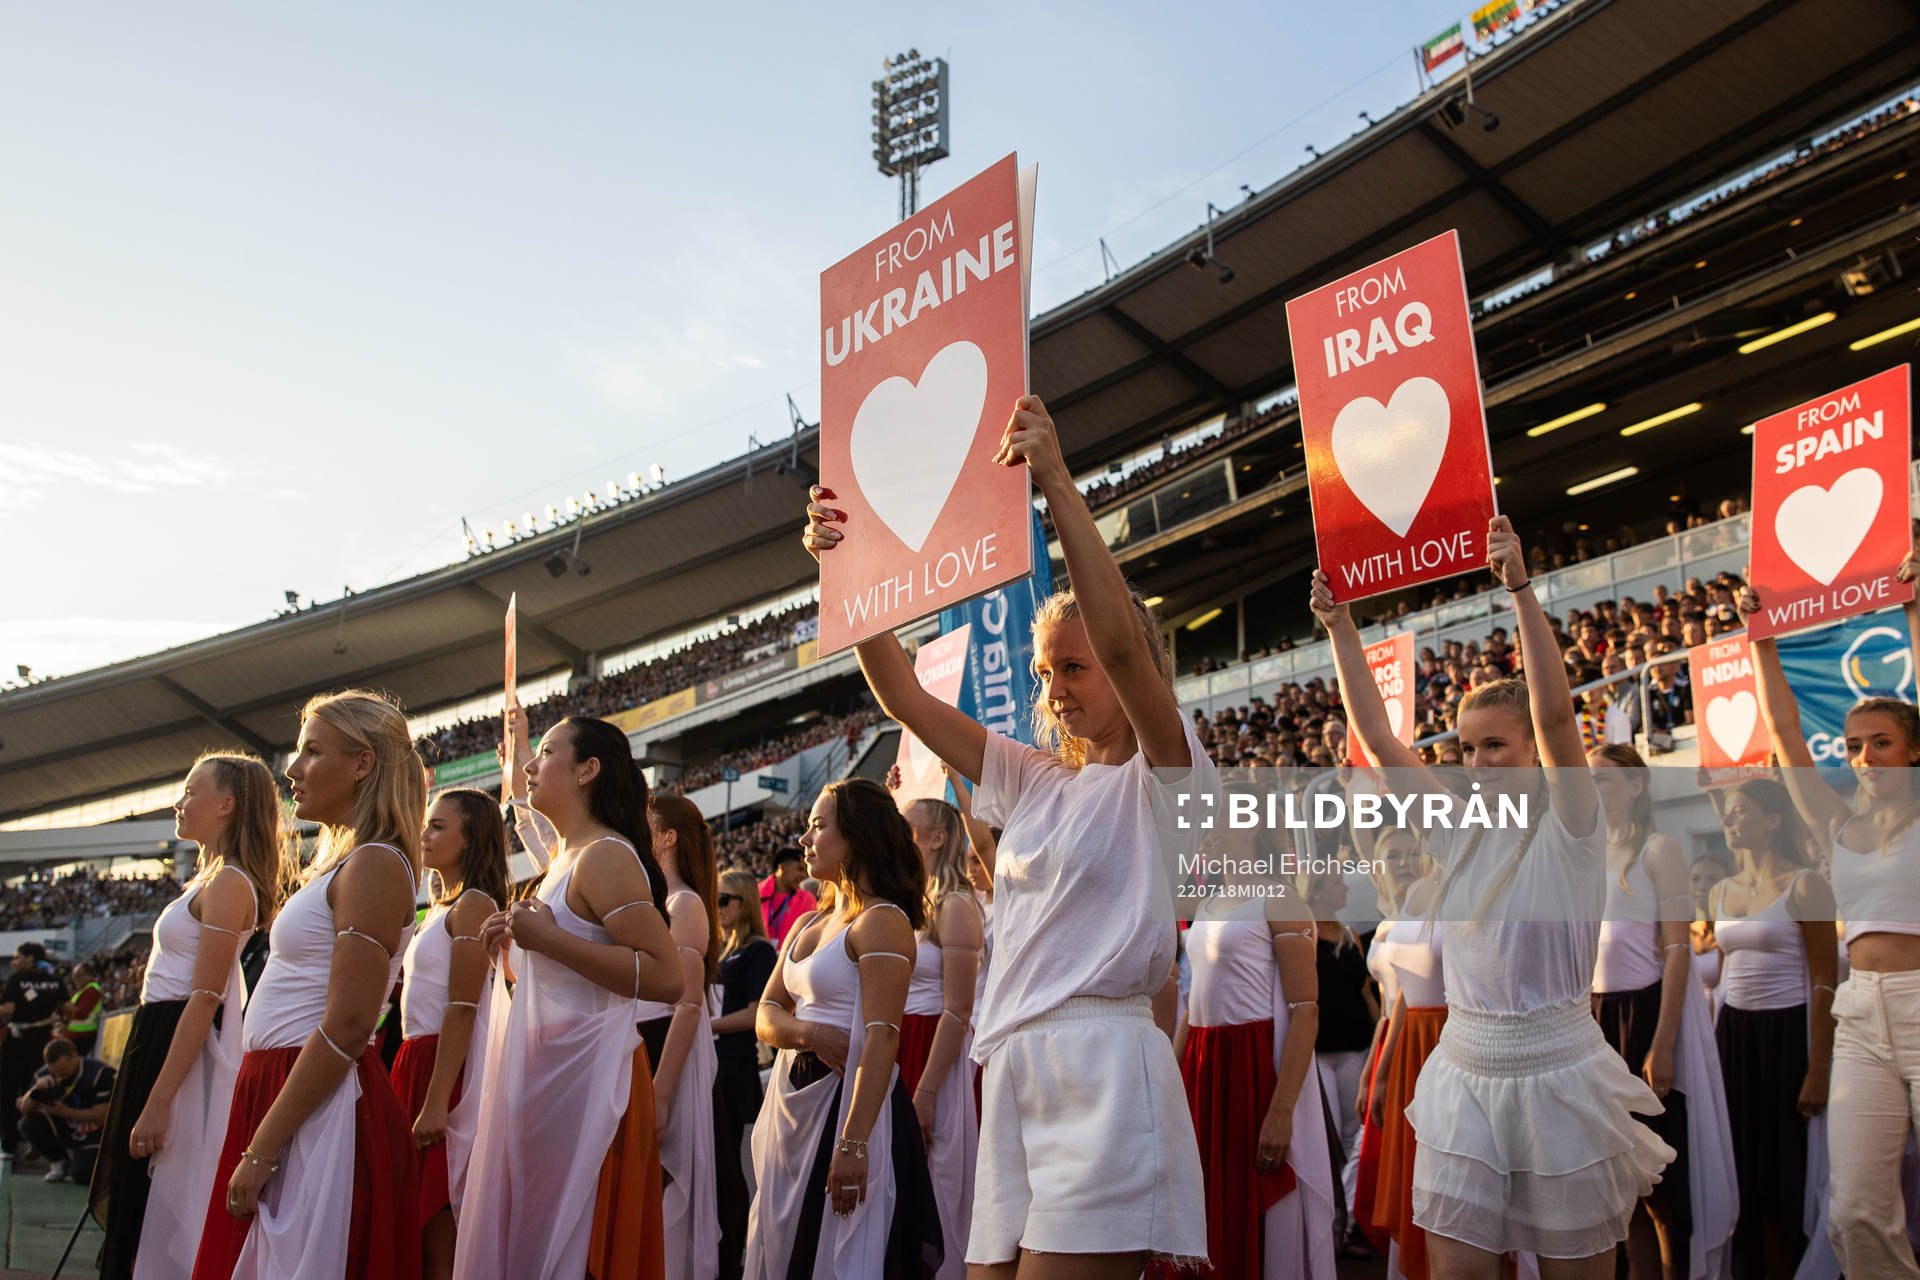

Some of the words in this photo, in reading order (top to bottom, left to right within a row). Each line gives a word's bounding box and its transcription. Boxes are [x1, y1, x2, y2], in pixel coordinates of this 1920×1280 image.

[875, 209, 955, 281] FROM
[825, 220, 1015, 366] UKRAINE
[1335, 266, 1407, 317] FROM
[1323, 301, 1435, 377] IRAQ
[1797, 393, 1861, 431] FROM
[1775, 410, 1884, 474] SPAIN
[843, 569, 913, 628] WITH
[924, 533, 997, 596] LOVE
[1341, 549, 1403, 589] WITH
[1411, 530, 1474, 572] LOVE
[1767, 598, 1825, 627] WITH
[1832, 577, 1890, 610] LOVE
[1366, 644, 1394, 664] FROM
[1373, 660, 1401, 684] ROE
[1702, 657, 1754, 687] INDIA
[1709, 642, 1742, 660] FROM
